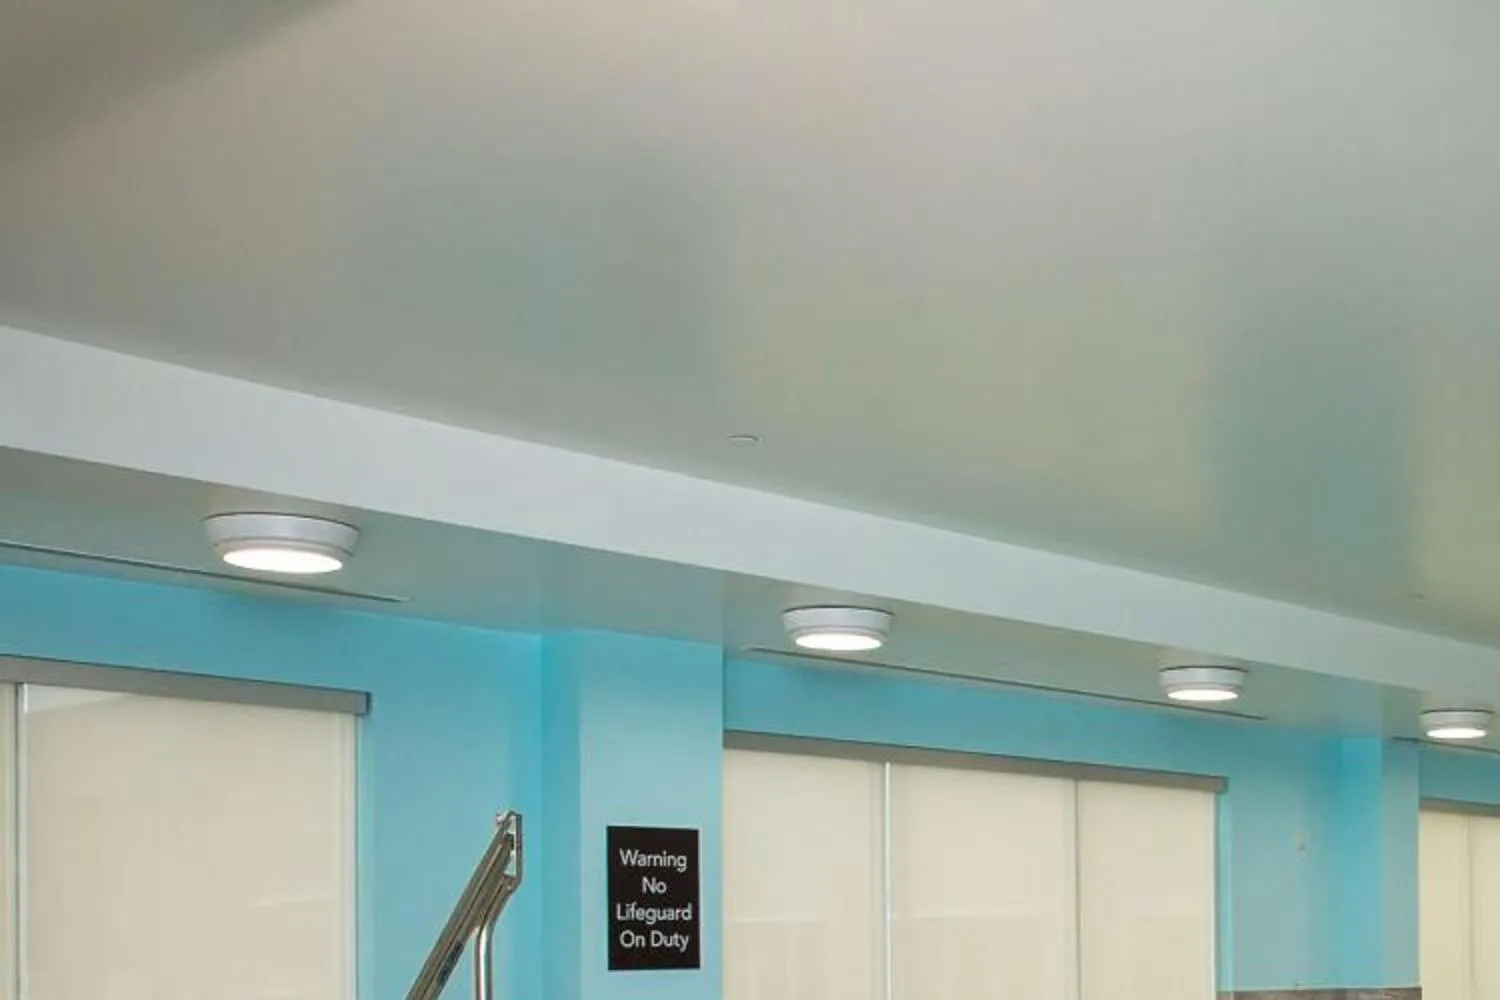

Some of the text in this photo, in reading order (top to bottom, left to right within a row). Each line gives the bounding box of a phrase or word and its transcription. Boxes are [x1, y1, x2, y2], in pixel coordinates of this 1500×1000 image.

[619, 847, 687, 872] Warning
[641, 876, 667, 894] No
[616, 902, 693, 925] Lifeguard
[619, 930, 689, 953] On Duty
